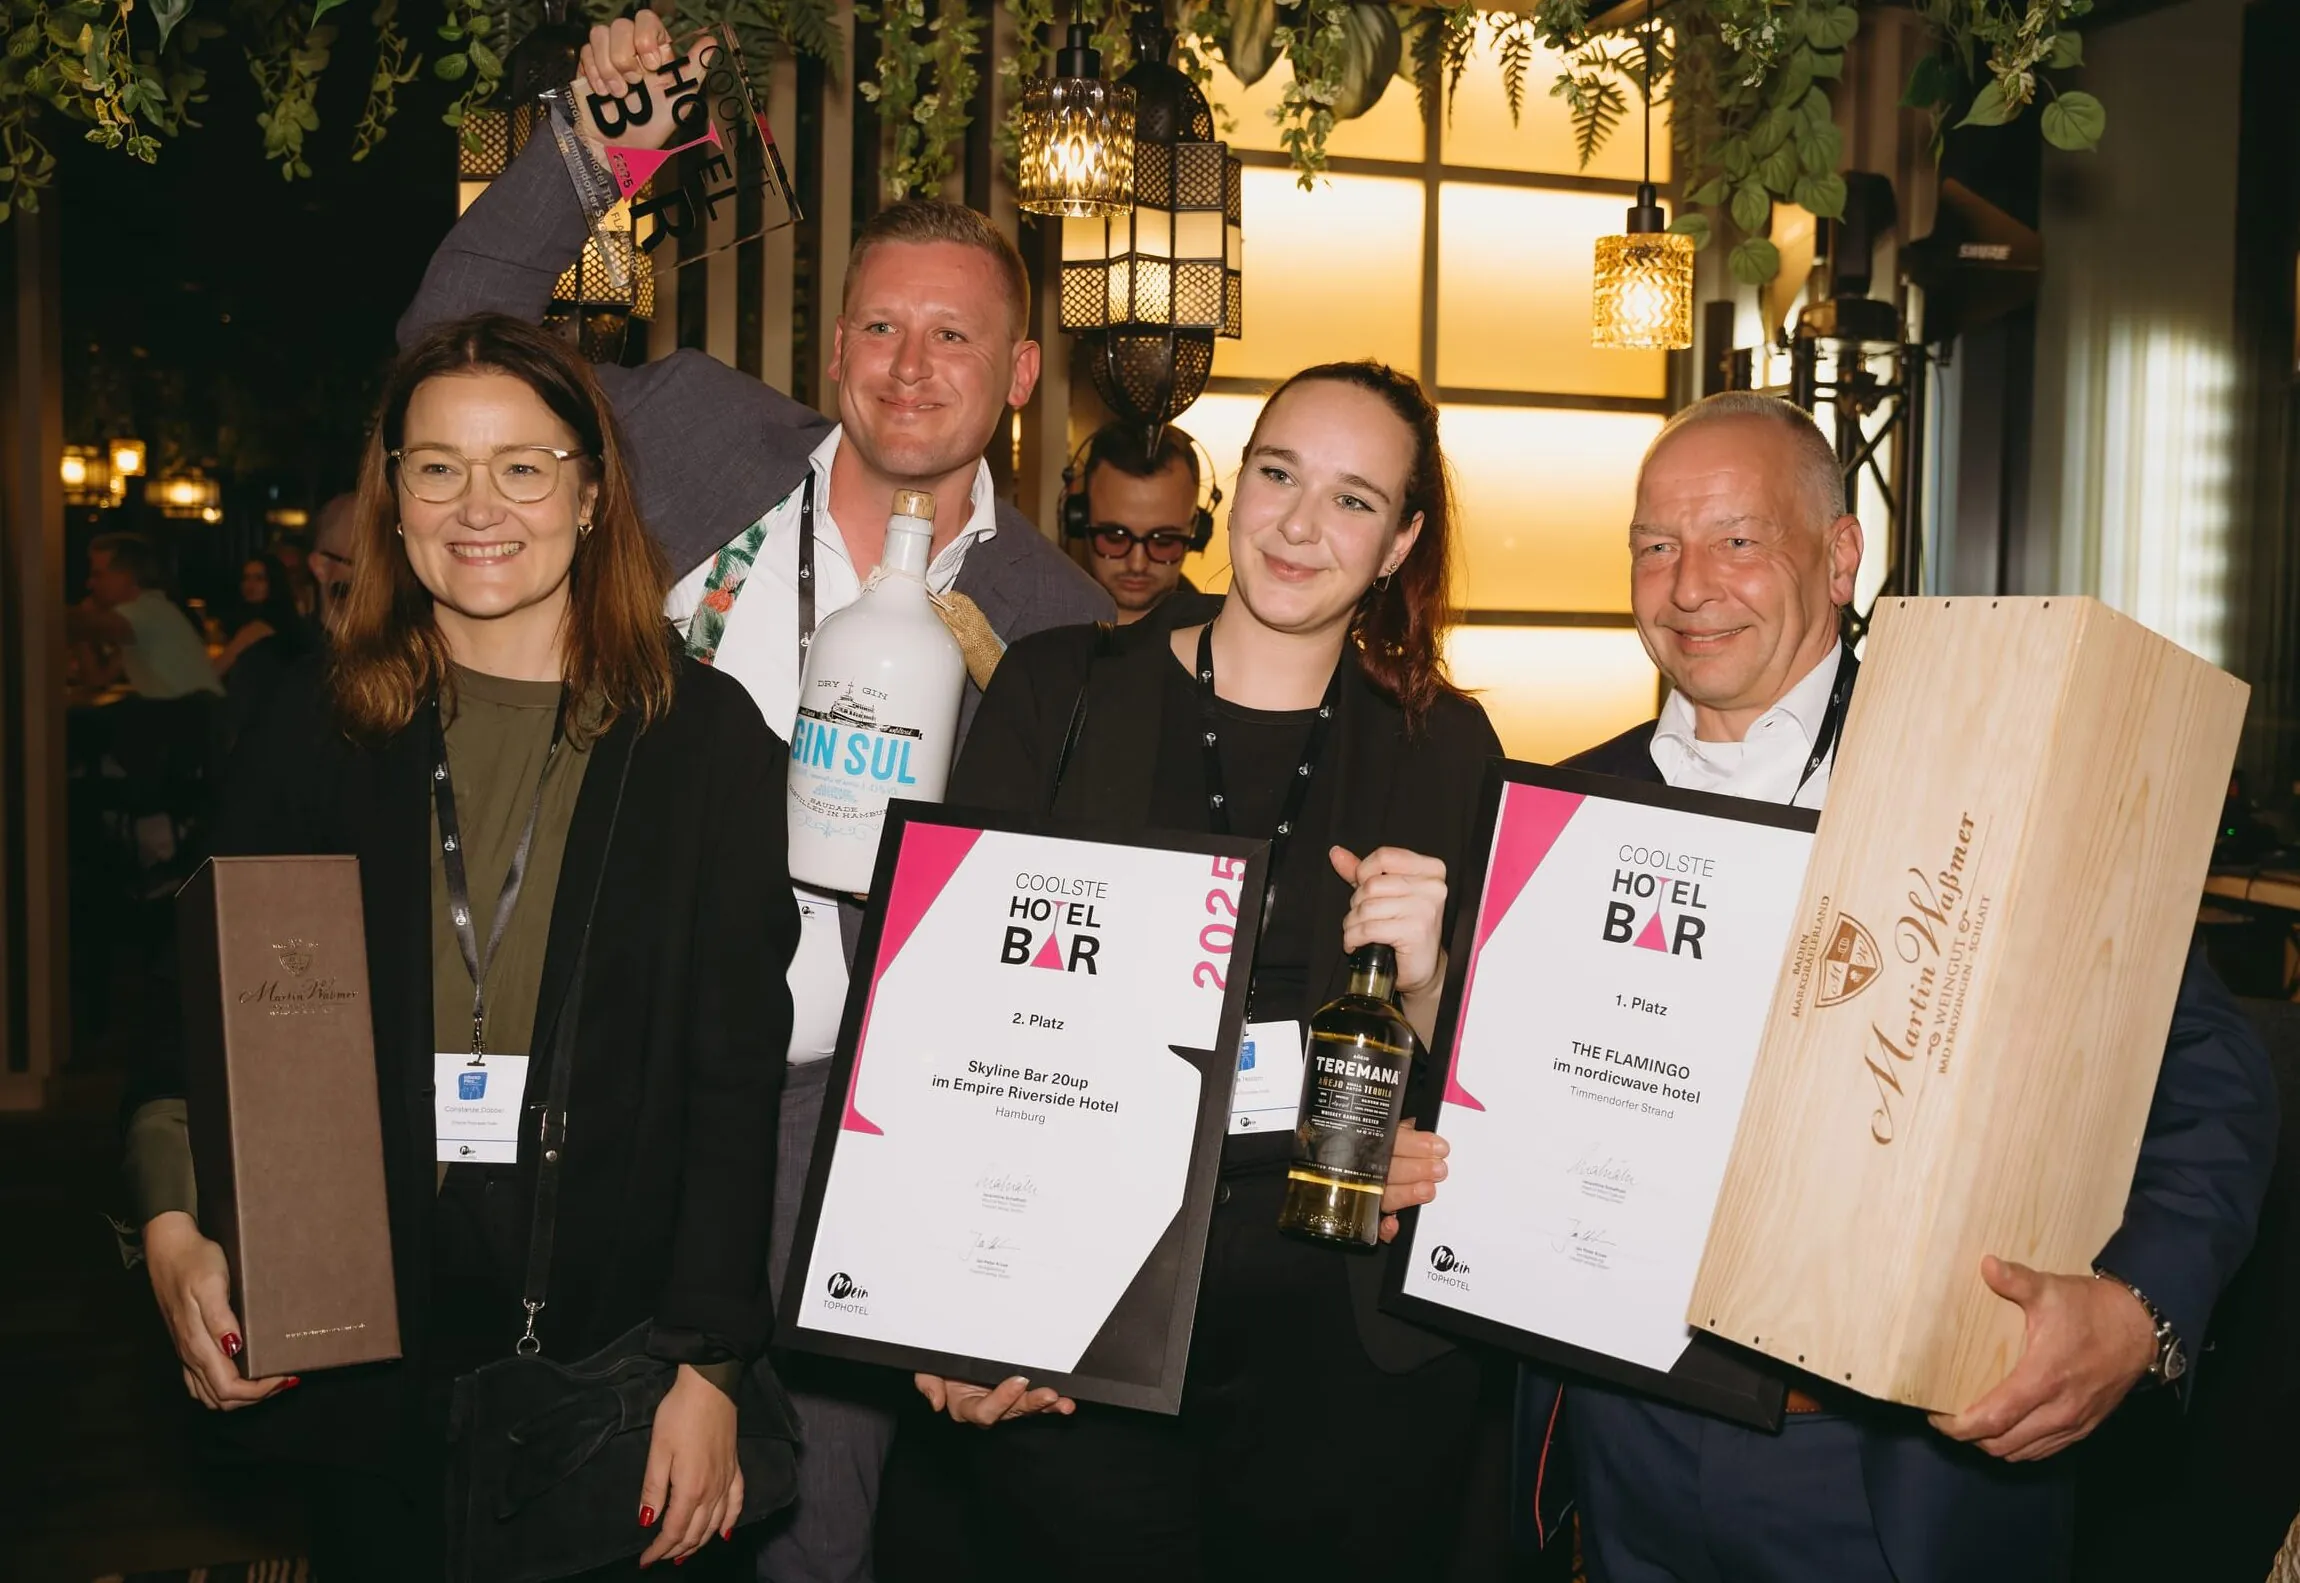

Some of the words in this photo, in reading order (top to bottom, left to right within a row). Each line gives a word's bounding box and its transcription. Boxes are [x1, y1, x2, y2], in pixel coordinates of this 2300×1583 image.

[656, 56, 738, 222] HOTEL
[699, 45, 776, 200] COOLTE
[586, 79, 697, 254] BAR
[817, 679, 841, 688] DRY
[862, 687, 889, 701] GIN
[792, 716, 839, 770] GIN
[844, 732, 917, 785] SUL
[810, 797, 859, 813] SAUDADE
[826, 809, 840, 818] IN
[1618, 844, 1716, 878] COOLSTE
[1015, 871, 1109, 899] COOLSTE
[1611, 868, 1708, 910] HOTEL
[1009, 895, 1102, 929] HOTEL
[1192, 855, 1247, 994] 2025
[1602, 900, 1706, 960] BAR
[1000, 924, 1101, 976] BAR
[1792, 934, 1809, 976] BADEN
[239, 980, 303, 1004] Martin
[1934, 936, 1966, 1026] WEINGUT
[1938, 1047, 1952, 1074] BAD
[1947, 963, 1973, 1045] KROZINGEN
[1968, 896, 1992, 953] SCHLATT
[1012, 1012, 1025, 1026] 2.
[1029, 1014, 1065, 1031] Platz
[1615, 994, 1627, 1008] 1.
[1631, 997, 1668, 1016] Platz
[1316, 1056, 1399, 1086] TEREMANA
[1571, 1041, 1602, 1060] THE
[1605, 1048, 1691, 1080] FLAMINGO
[1864, 966, 1937, 1145] Martin
[967, 1060, 1021, 1081] Skyline
[1023, 1068, 1049, 1084] Bar
[1052, 1072, 1089, 1091] 20up
[1318, 1076, 1344, 1089] AÑEJO
[1364, 1085, 1392, 1098] TEQUILA
[1553, 1057, 1572, 1073] im
[1574, 1063, 1659, 1094] nordicwave
[1662, 1083, 1701, 1104] hotel
[931, 1074, 950, 1090] im
[953, 1077, 1005, 1100] Empire
[1008, 1086, 1075, 1108] Riverside
[1079, 1095, 1120, 1114] Hotel
[1570, 1085, 1639, 1111] Timmendorfer
[1641, 1103, 1674, 1119] Strand
[995, 1106, 1046, 1125] Hamburg
[1431, 1245, 1470, 1275] Mein
[828, 1272, 869, 1299] Mein
[1426, 1270, 1471, 1291] TOPHOTEL
[823, 1300, 869, 1316] TOPHOTEL
